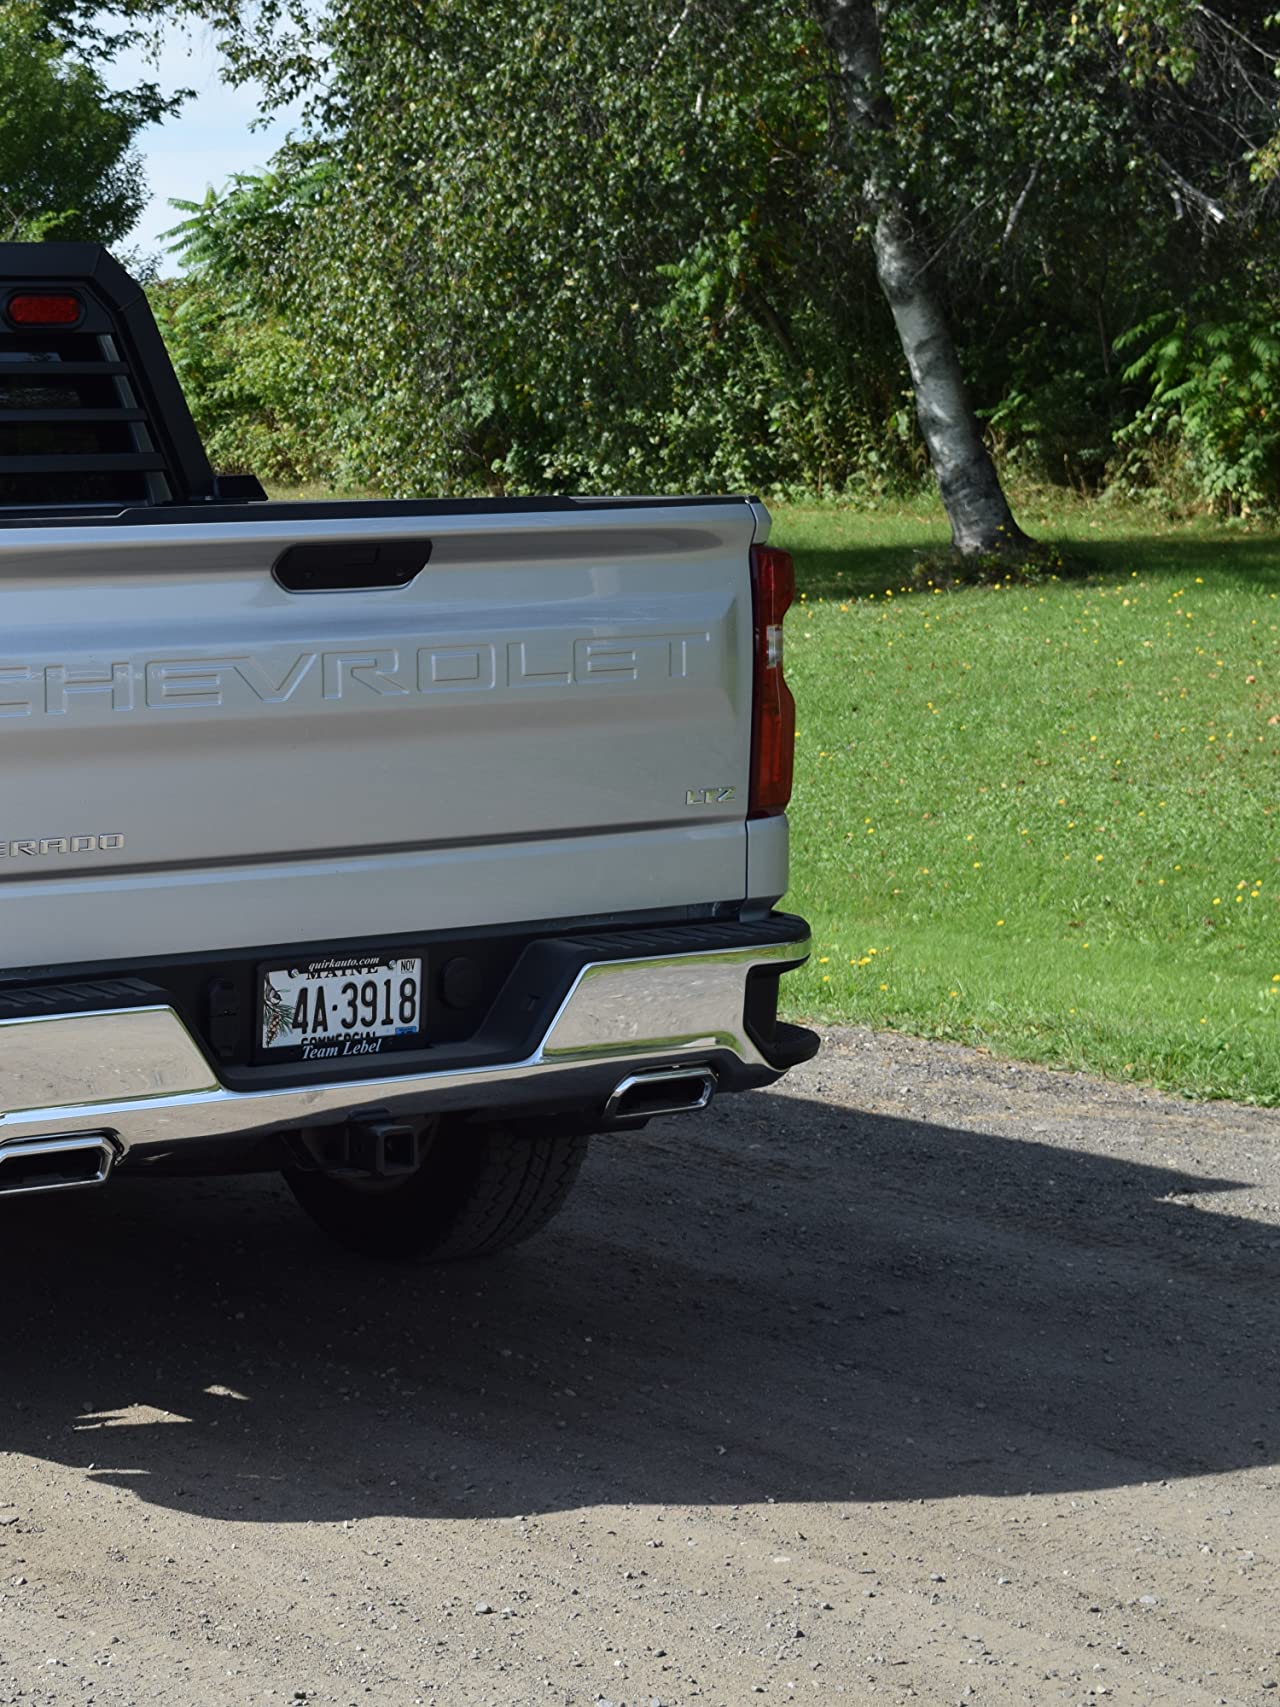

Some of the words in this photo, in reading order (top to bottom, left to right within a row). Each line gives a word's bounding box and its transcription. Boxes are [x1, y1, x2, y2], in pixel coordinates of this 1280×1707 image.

[685, 786, 736, 805] LTZ
[308, 957, 380, 971] quirkauto.com
[401, 960, 416, 971] NOV
[306, 966, 379, 980] MAINE
[302, 1045, 339, 1060] Team
[342, 1038, 383, 1056] Lebel
